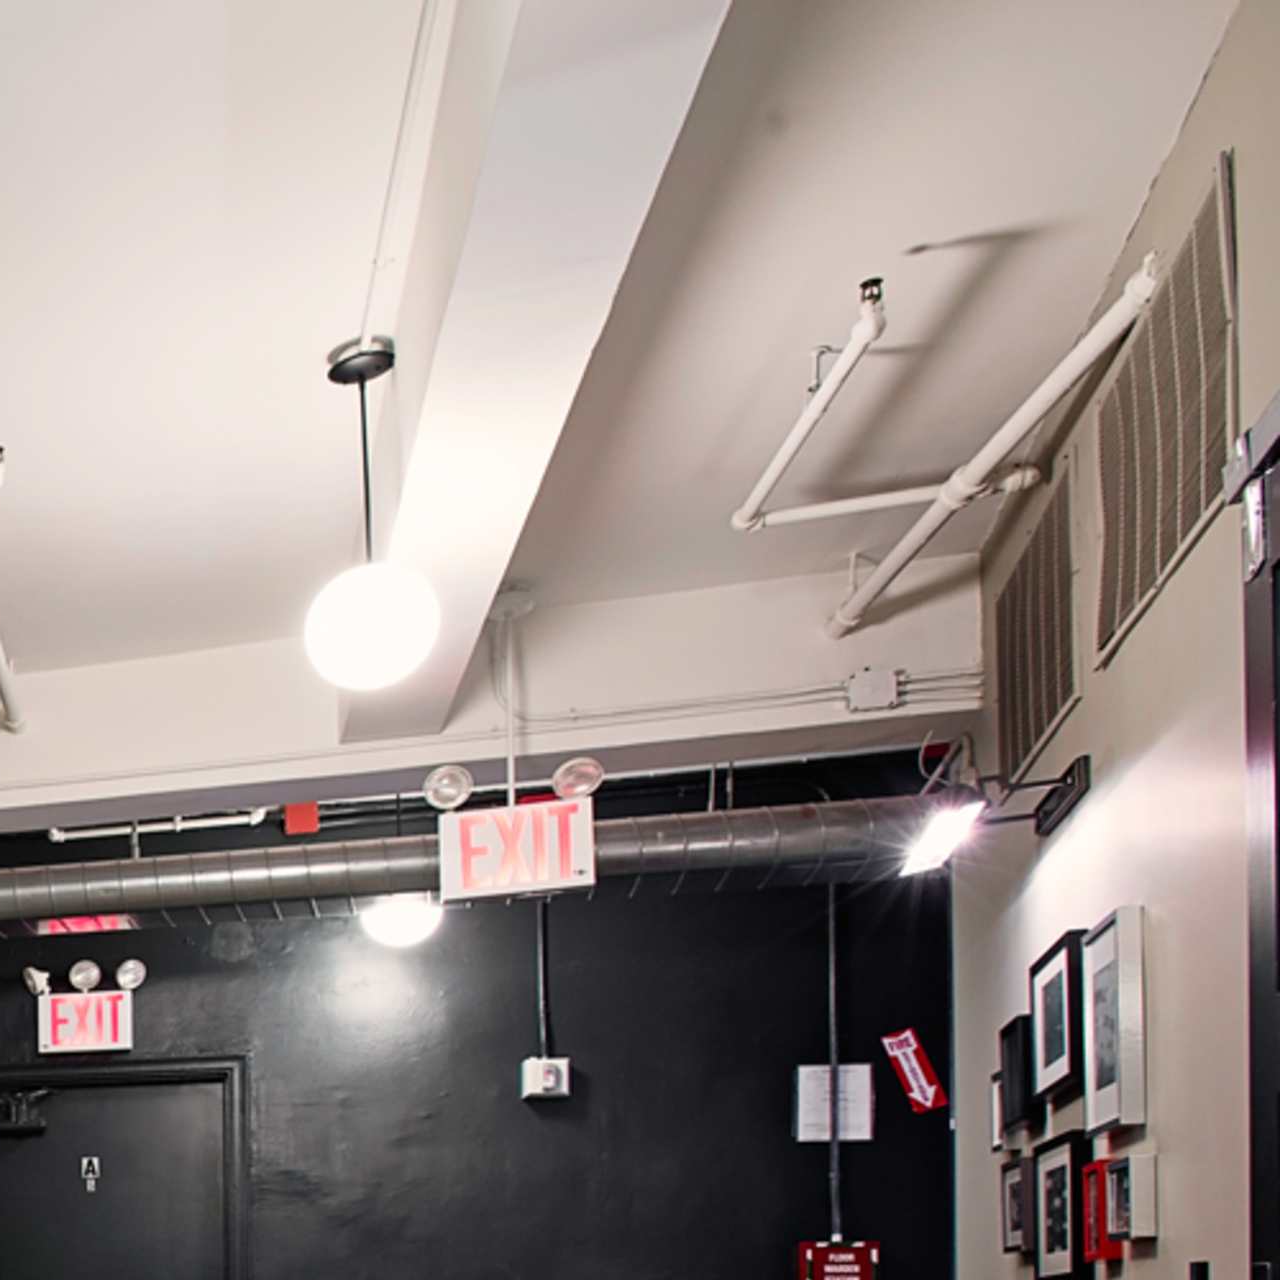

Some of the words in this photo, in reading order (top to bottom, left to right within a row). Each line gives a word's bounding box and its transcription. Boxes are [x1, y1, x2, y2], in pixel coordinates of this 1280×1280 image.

[459, 803, 578, 890] EXIT
[50, 993, 123, 1045] EXIT
[84, 1158, 96, 1176] A
